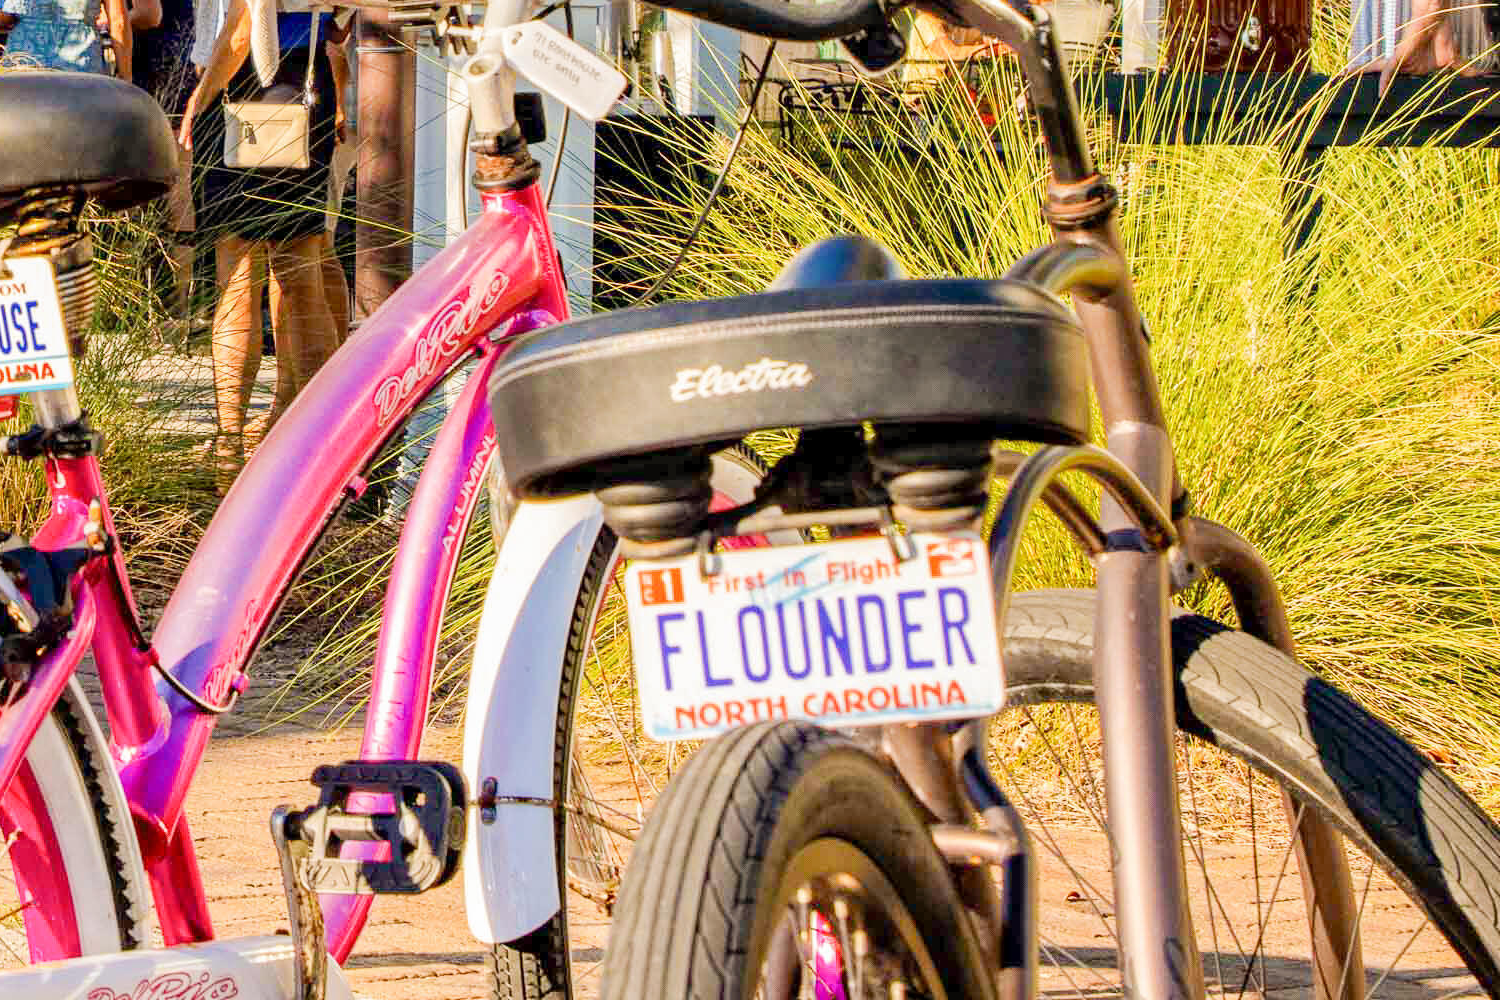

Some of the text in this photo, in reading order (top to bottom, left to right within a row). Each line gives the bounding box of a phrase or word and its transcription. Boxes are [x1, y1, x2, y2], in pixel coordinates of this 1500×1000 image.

[669, 357, 815, 403] Electra
[707, 571, 765, 594] First
[827, 557, 903, 585] Flight
[656, 587, 976, 691] FLOUNDER
[674, 679, 966, 729] NORTH CAROLINA
